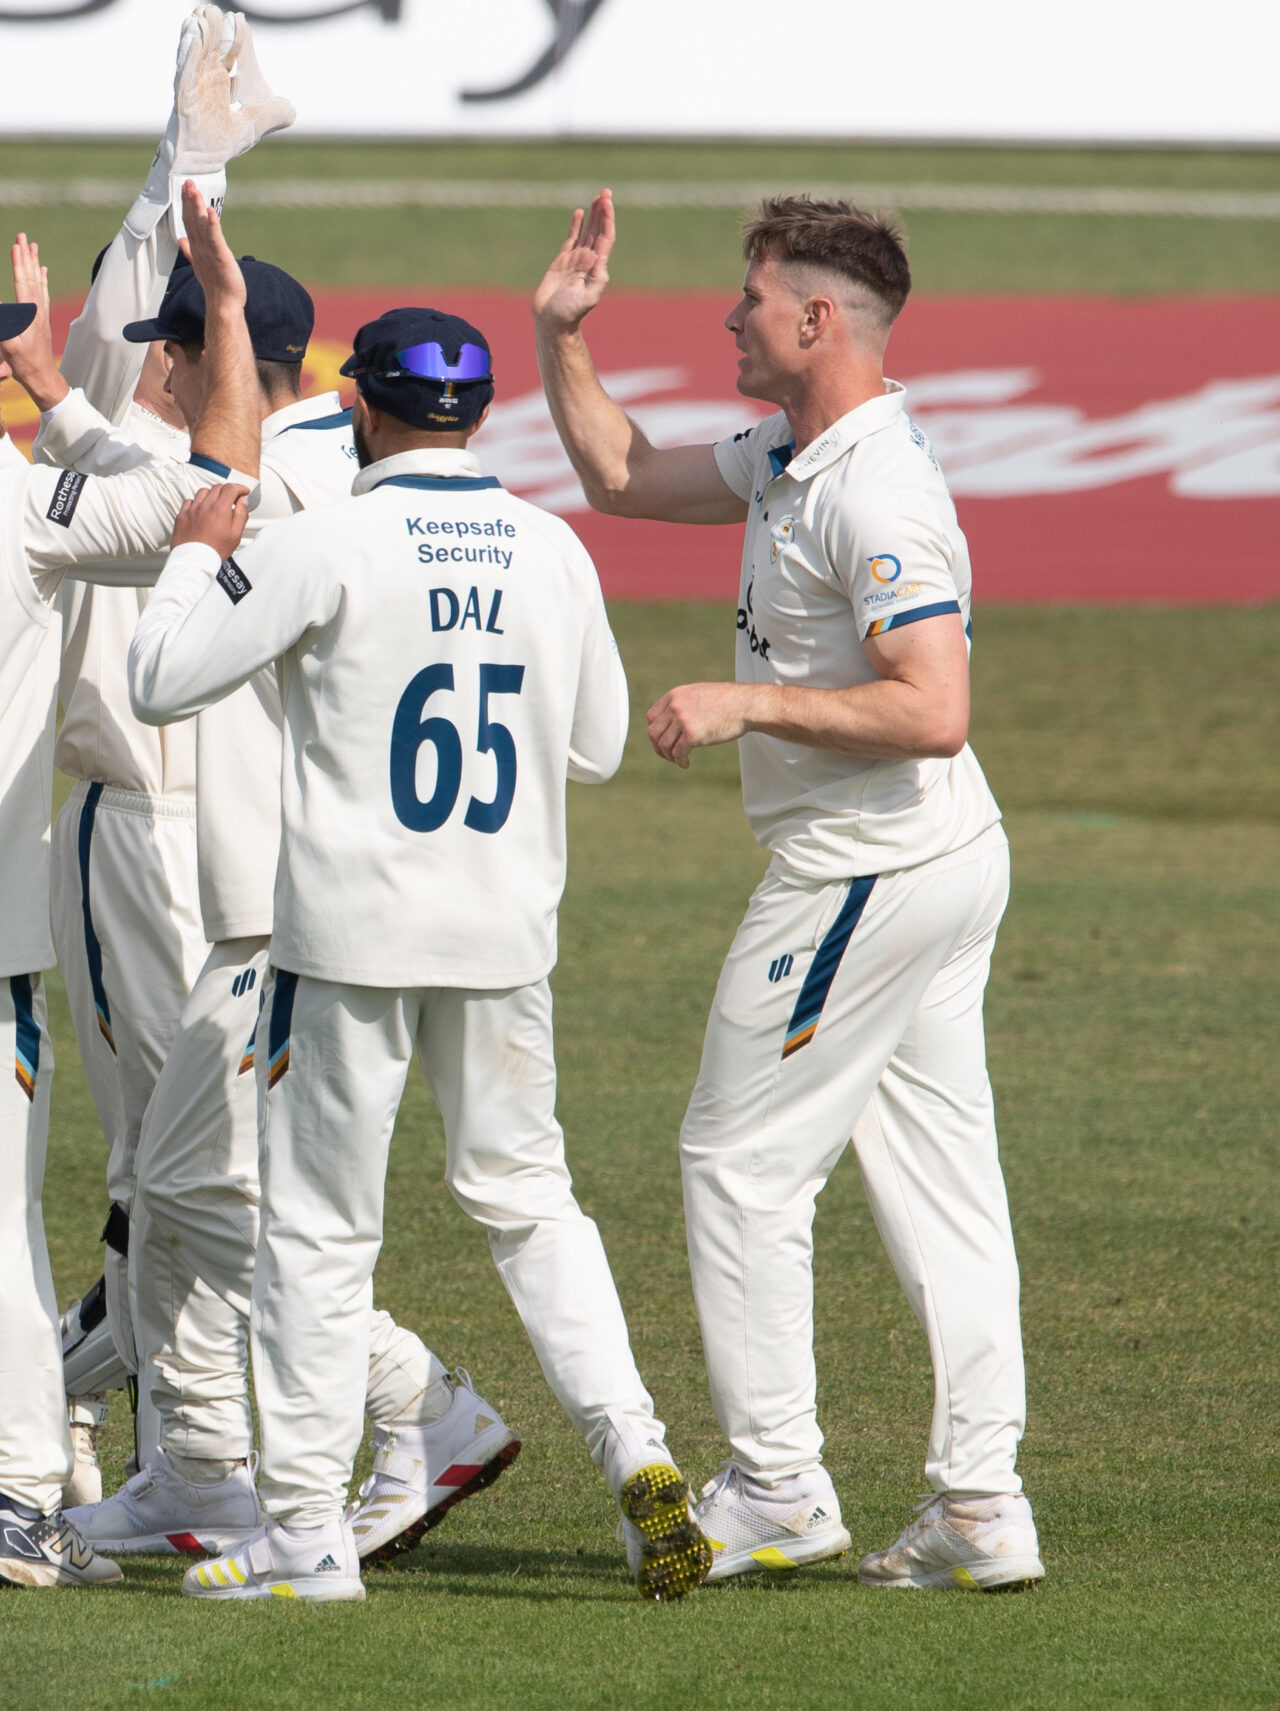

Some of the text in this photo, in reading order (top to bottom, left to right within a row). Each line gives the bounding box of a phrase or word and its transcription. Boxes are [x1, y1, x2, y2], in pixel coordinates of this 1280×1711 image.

[406, 517, 517, 538] Keepsafe
[417, 543, 513, 570] Security
[428, 586, 505, 635] DAL
[389, 662, 526, 834] 65
